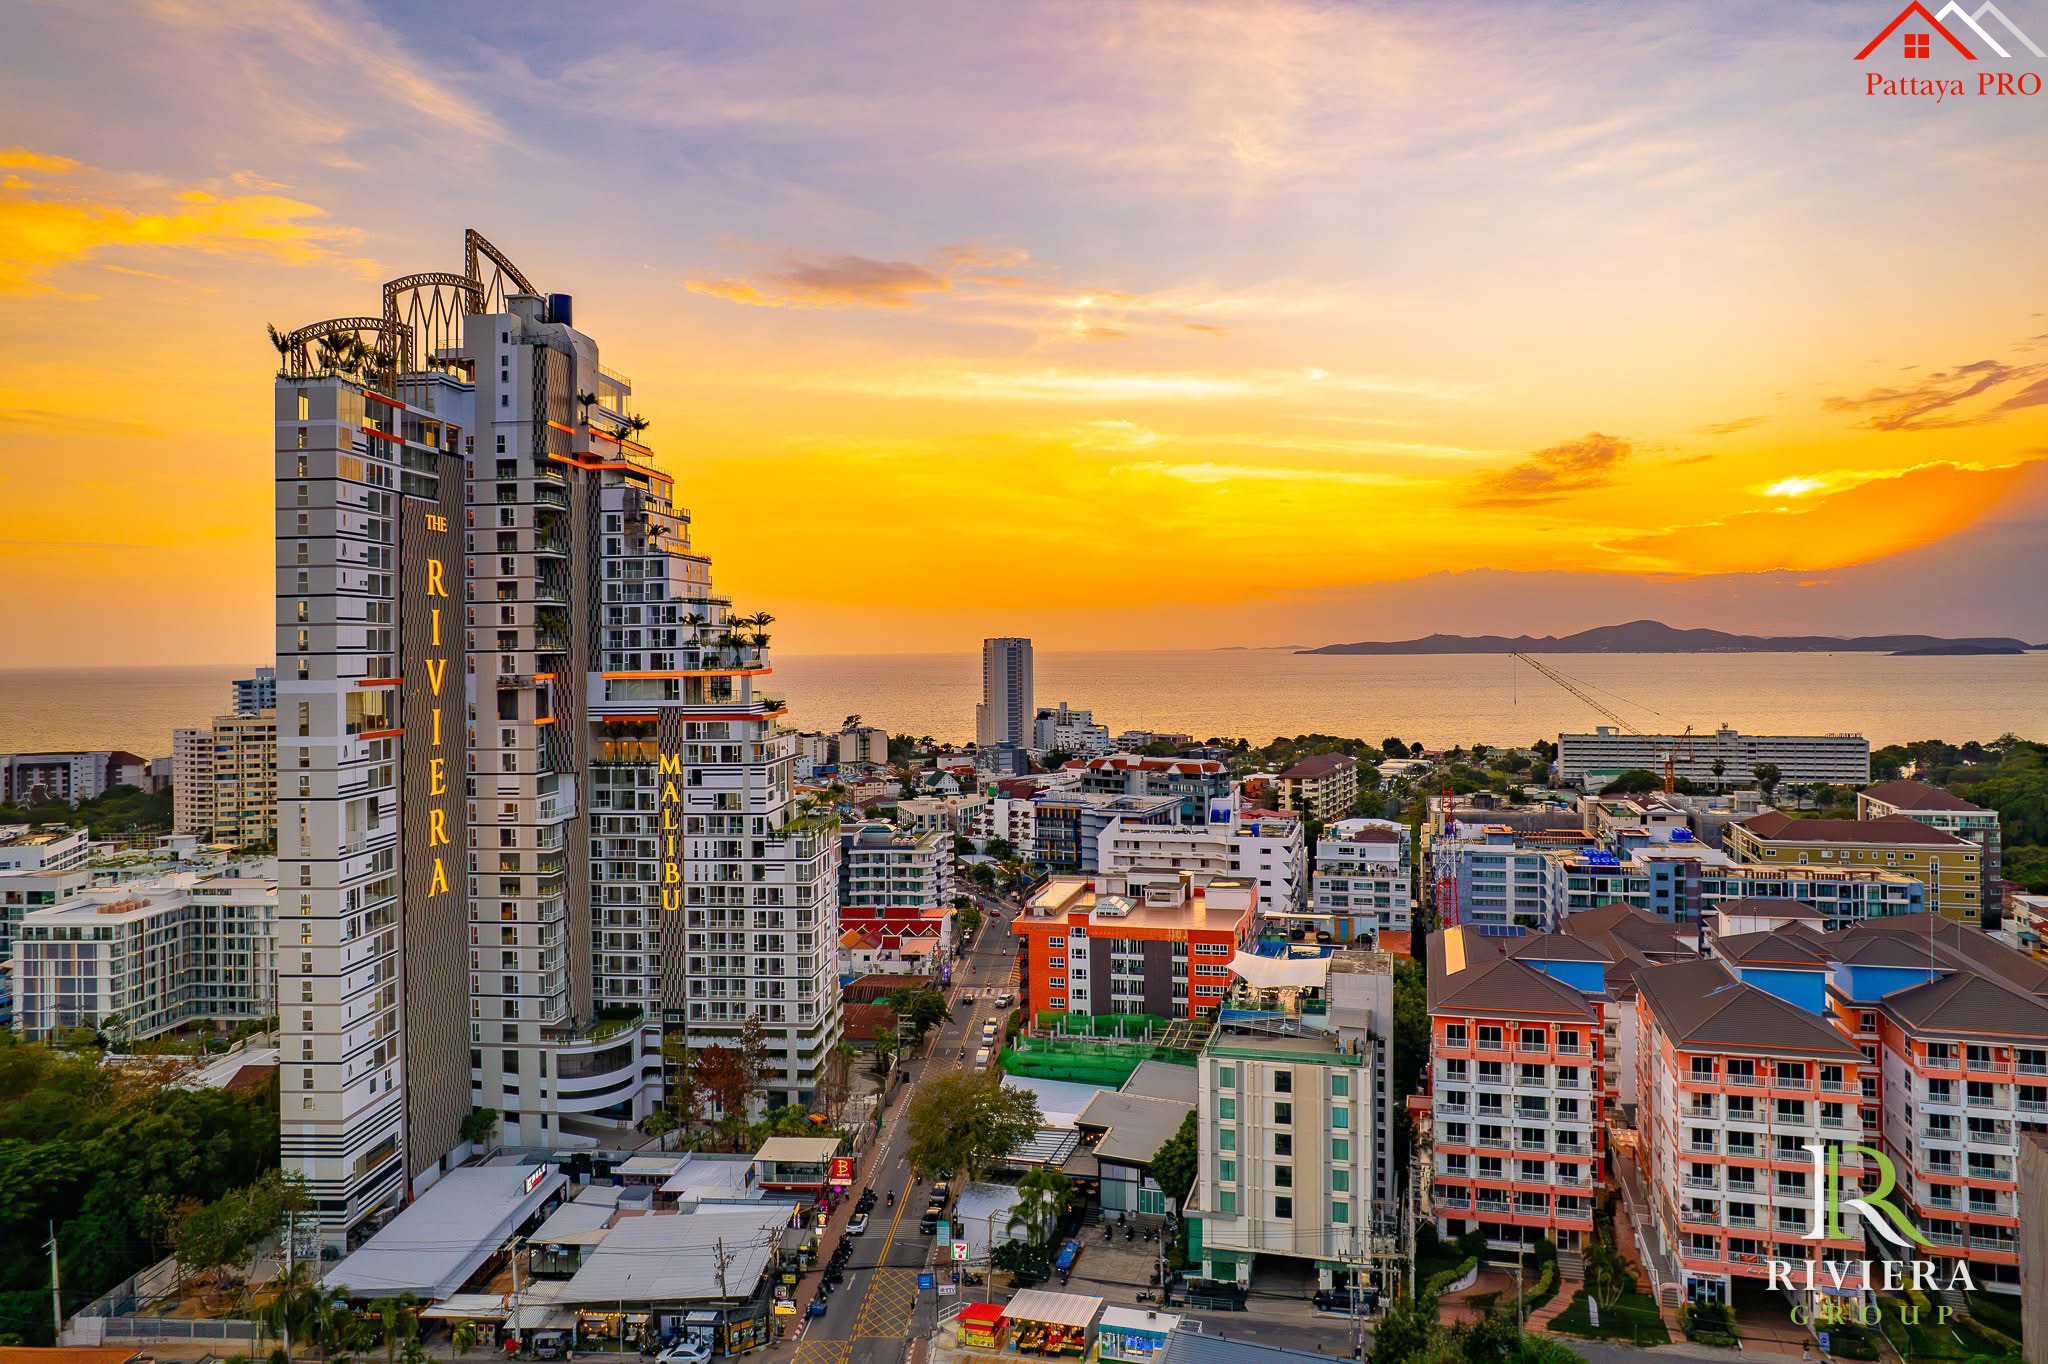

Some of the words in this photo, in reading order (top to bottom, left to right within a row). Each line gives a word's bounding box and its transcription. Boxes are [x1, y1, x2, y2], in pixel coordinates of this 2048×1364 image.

[425, 514, 448, 533] THE
[425, 559, 450, 898] RIVIERA
[658, 753, 682, 911] MALIBU
